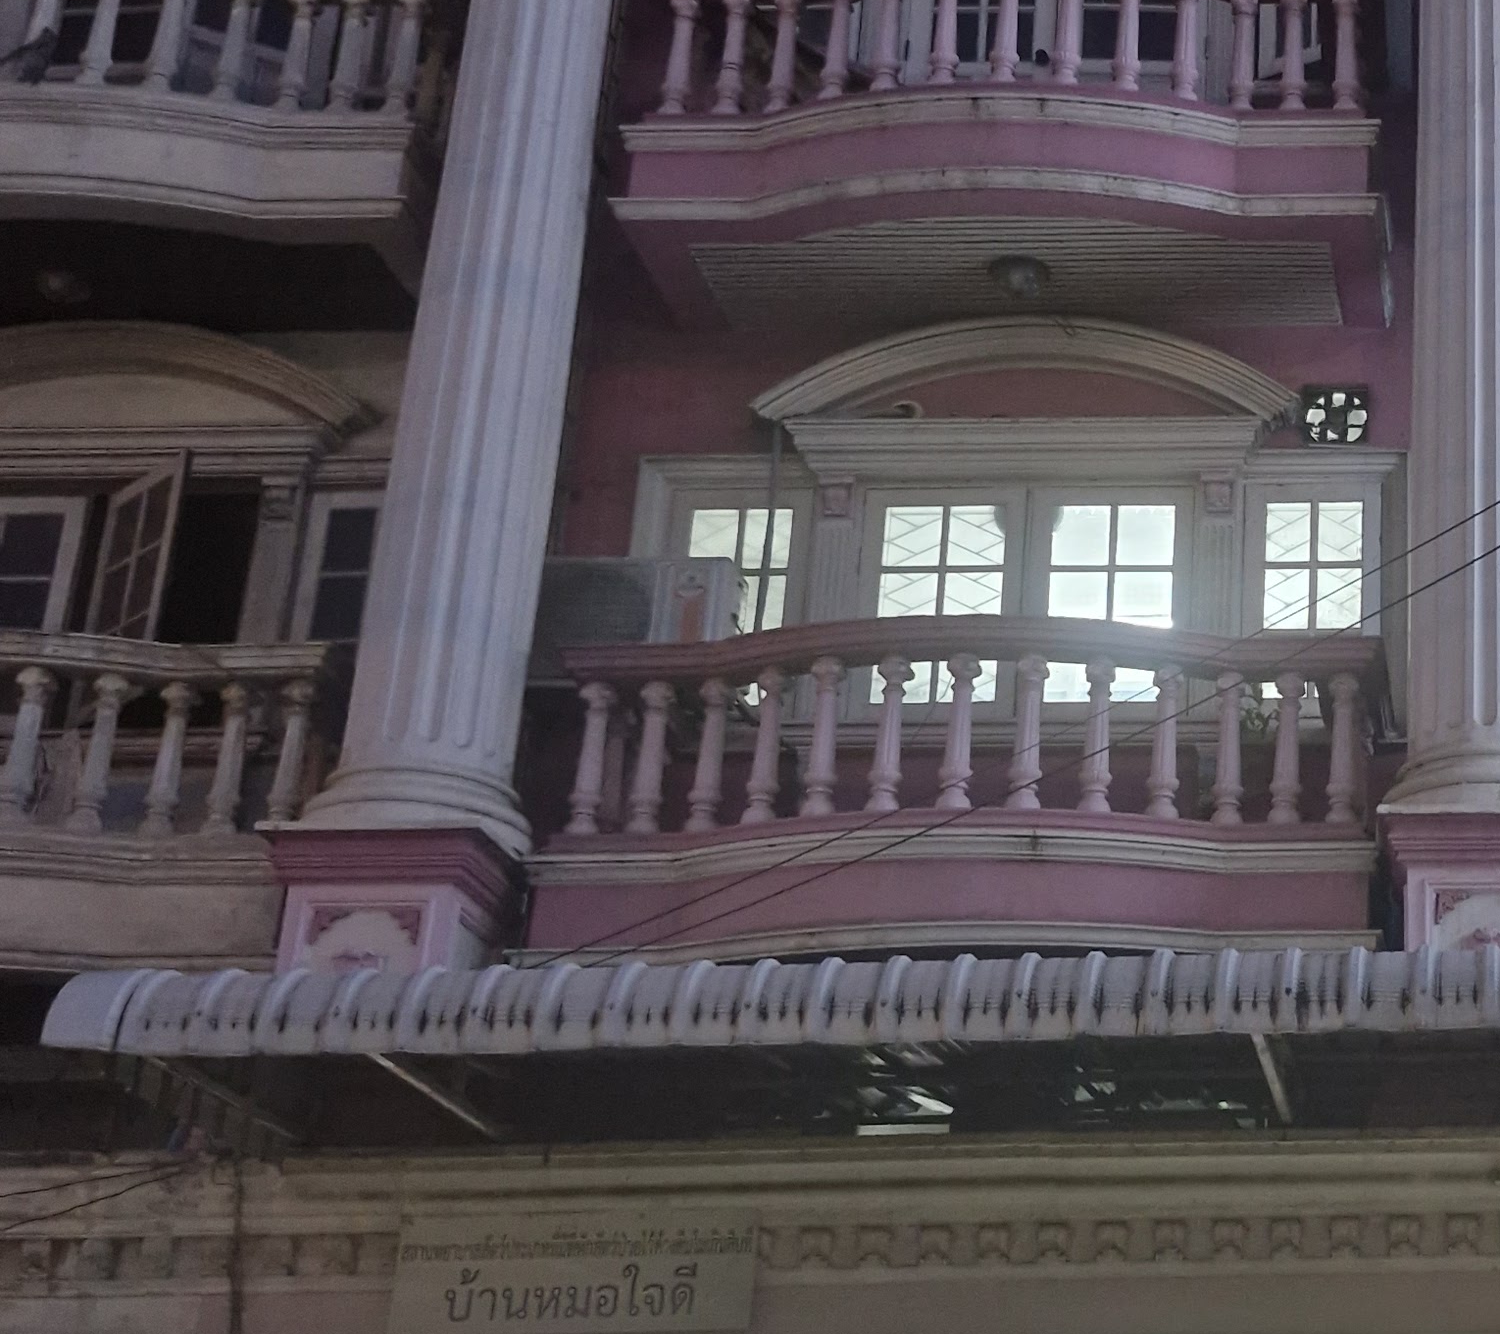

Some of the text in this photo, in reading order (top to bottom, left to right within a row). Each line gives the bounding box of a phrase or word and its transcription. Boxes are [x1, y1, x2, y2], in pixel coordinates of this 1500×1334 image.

[444, 1263, 698, 1322] บ้านหมอใจดี
